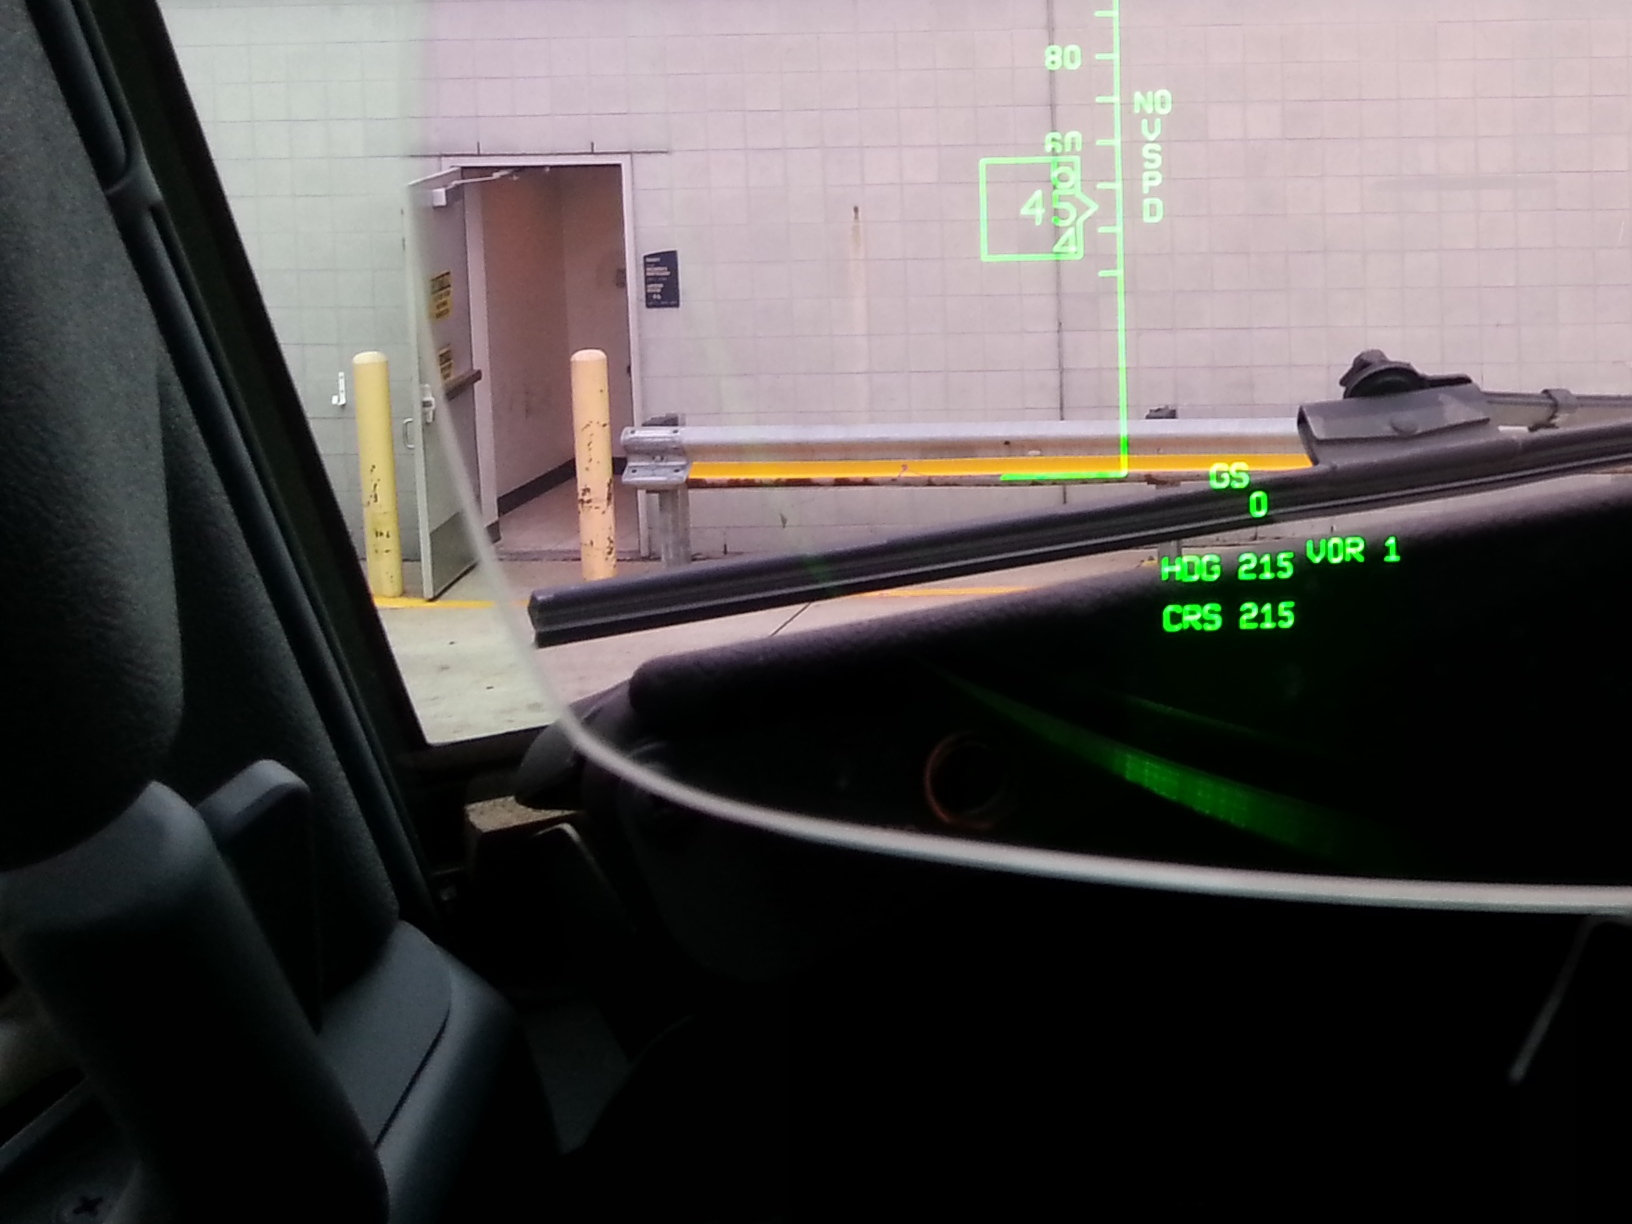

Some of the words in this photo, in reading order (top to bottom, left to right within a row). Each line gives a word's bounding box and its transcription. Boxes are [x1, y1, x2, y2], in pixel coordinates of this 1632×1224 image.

[1044, 44, 1082, 70] 80
[1133, 89, 1173, 115] NO
[1209, 462, 1251, 489] GS
[1306, 536, 1365, 564] VOR
[1383, 536, 1401, 563] 1
[1160, 554, 1221, 582] HDG
[1238, 551, 1295, 580] 215
[1162, 603, 1222, 632] CRS
[1239, 601, 1295, 629] 215
